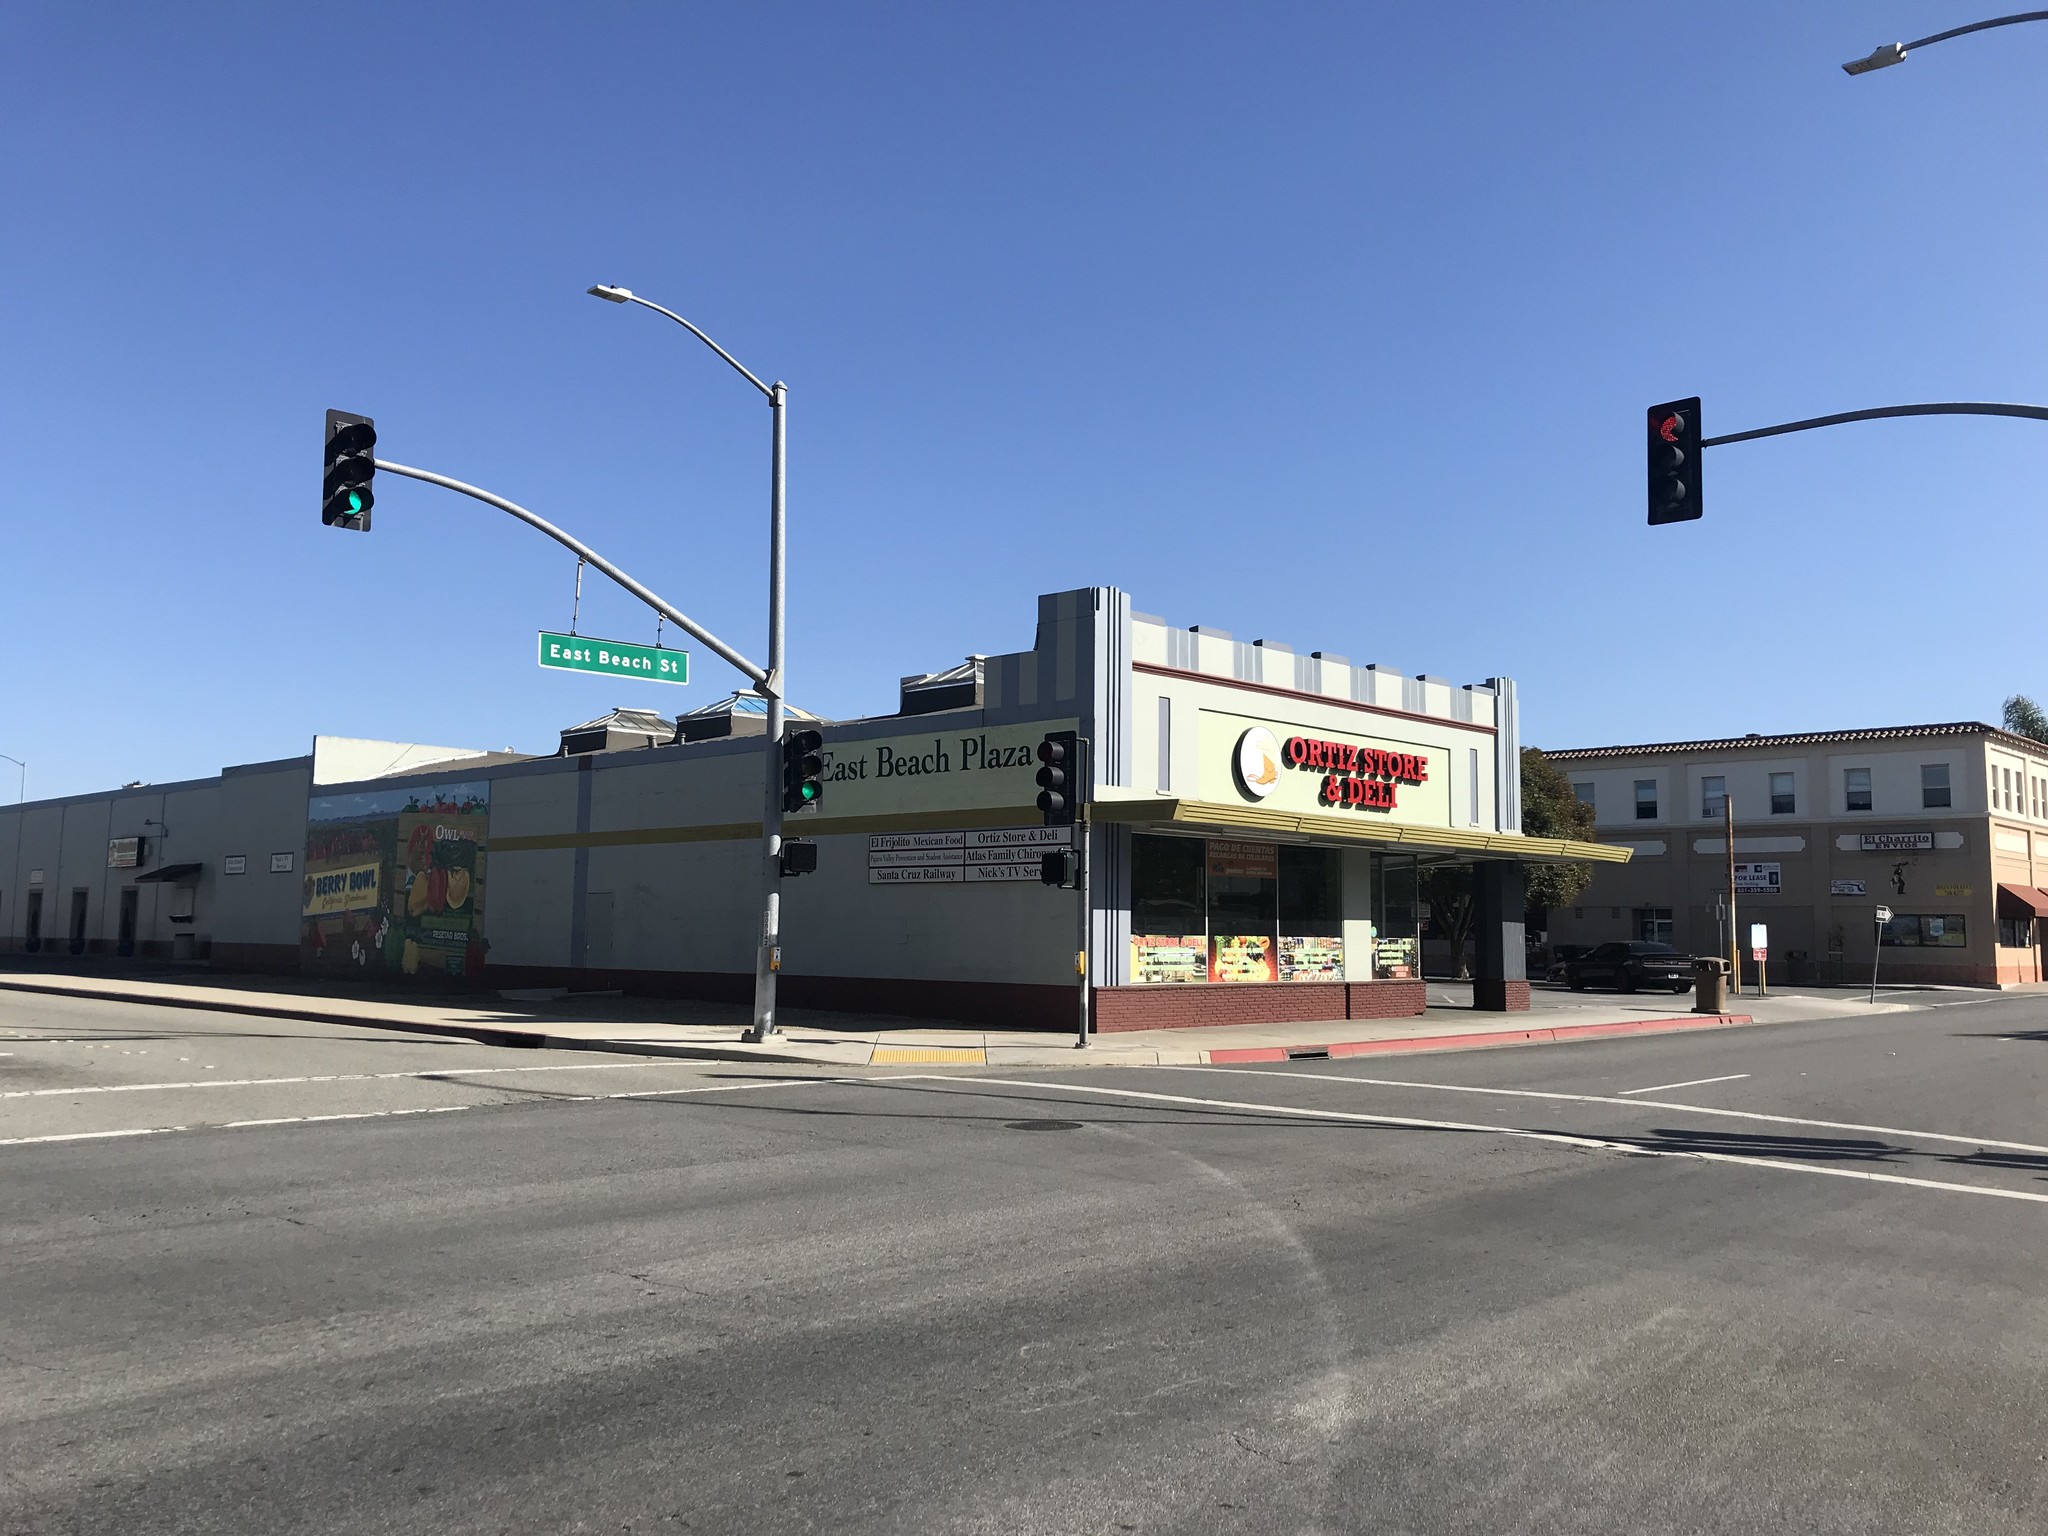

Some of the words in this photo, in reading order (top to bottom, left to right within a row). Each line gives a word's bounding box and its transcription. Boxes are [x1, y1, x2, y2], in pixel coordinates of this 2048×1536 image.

[550, 643, 591, 662] East
[599, 650, 651, 670] Beach
[660, 659, 678, 674] St
[822, 751, 868, 782] East
[875, 739, 951, 778] Beach
[959, 734, 1034, 771] Plaza
[1289, 736, 1358, 773] ORTIZ
[1364, 747, 1429, 782] STORE
[1326, 775, 1343, 802] &
[1347, 777, 1398, 809] DELI
[871, 837, 879, 848] El
[881, 836, 910, 849] Frijolito
[913, 836, 943, 846] Mexican
[945, 835, 963, 845] Food
[978, 832, 1001, 844] Ortiz
[1003, 831, 1026, 843] Store
[1028, 830, 1037, 842] &
[1039, 829, 1058, 841] Deli
[1864, 835, 1875, 843] El
[1878, 834, 1930, 843] Charrito
[1209, 841, 1230, 852] PAGO
[1231, 843, 1241, 853] DE
[1242, 844, 1275, 855] CUENTAS
[883, 854, 895, 864] Valley
[917, 853, 925, 861] and
[966, 850, 986, 862] Atlas
[988, 849, 1016, 862] Family
[877, 869, 899, 880] Santa
[901, 869, 921, 880] Cruz
[923, 868, 956, 881] Railway
[978, 866, 1005, 878] Nick's
[1007, 865, 1021, 877] TV
[316, 872, 347, 898] BERRY
[350, 868, 377, 892] BOWL
[432, 930, 453, 940] RESETAR
[453, 931, 469, 941] BROS.
[1134, 936, 1155, 947] ORTIZ
[1157, 937, 1179, 947] STORE
[1188, 938, 1203, 947] DELI
